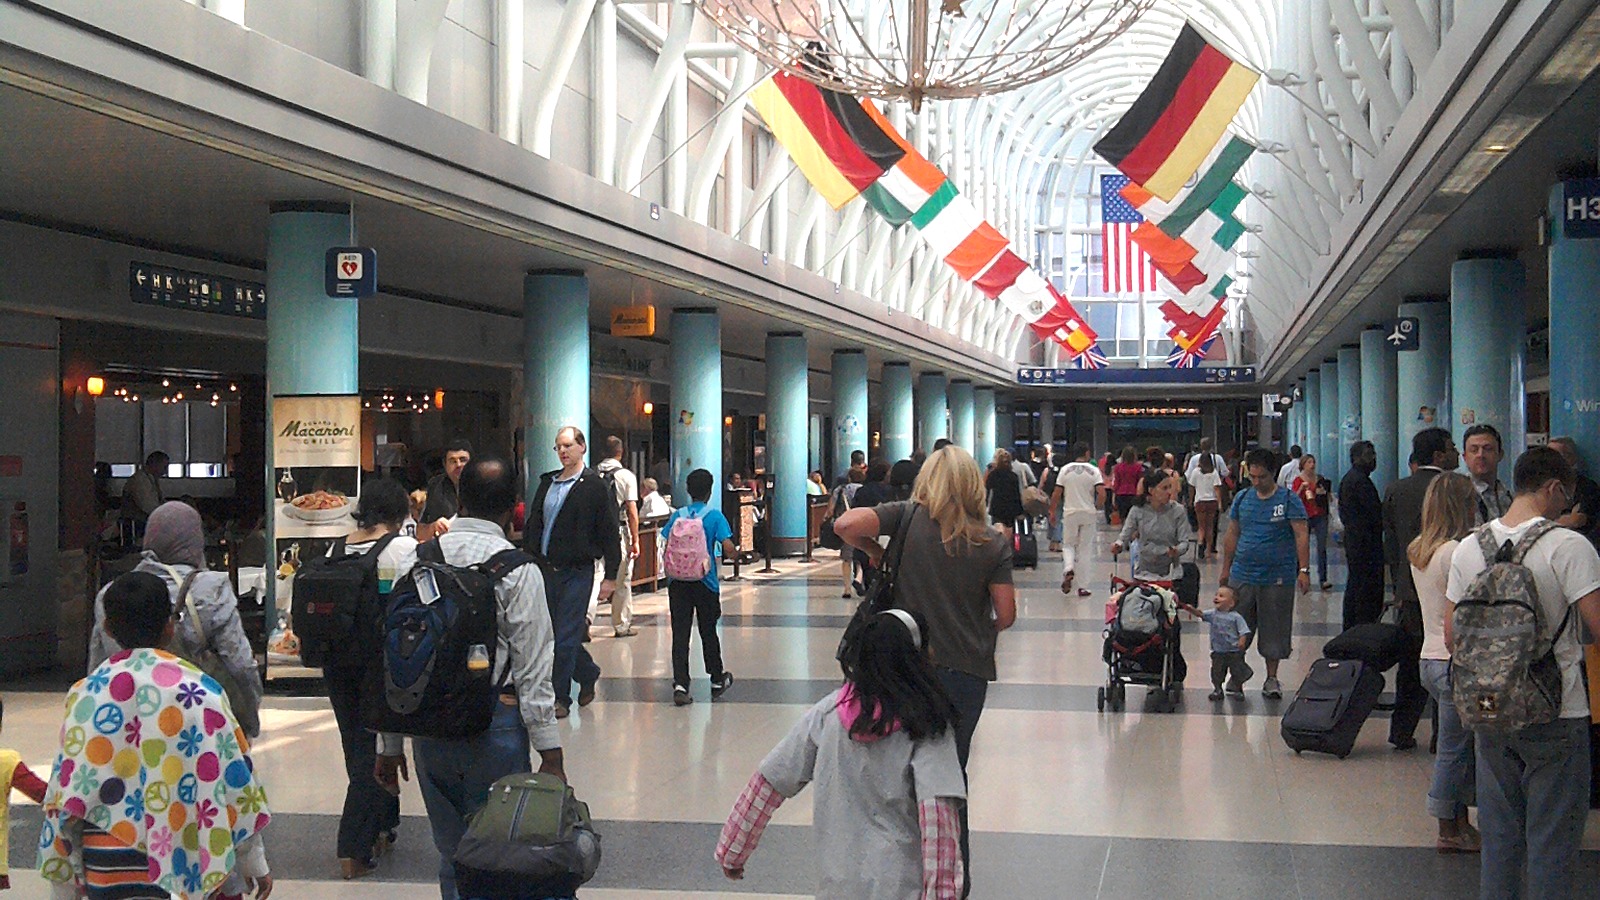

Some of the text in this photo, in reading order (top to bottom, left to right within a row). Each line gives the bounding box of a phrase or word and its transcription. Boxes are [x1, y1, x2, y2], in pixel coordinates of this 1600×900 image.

[152, 274, 173, 290] H K
[278, 420, 355, 437] Macaroni
